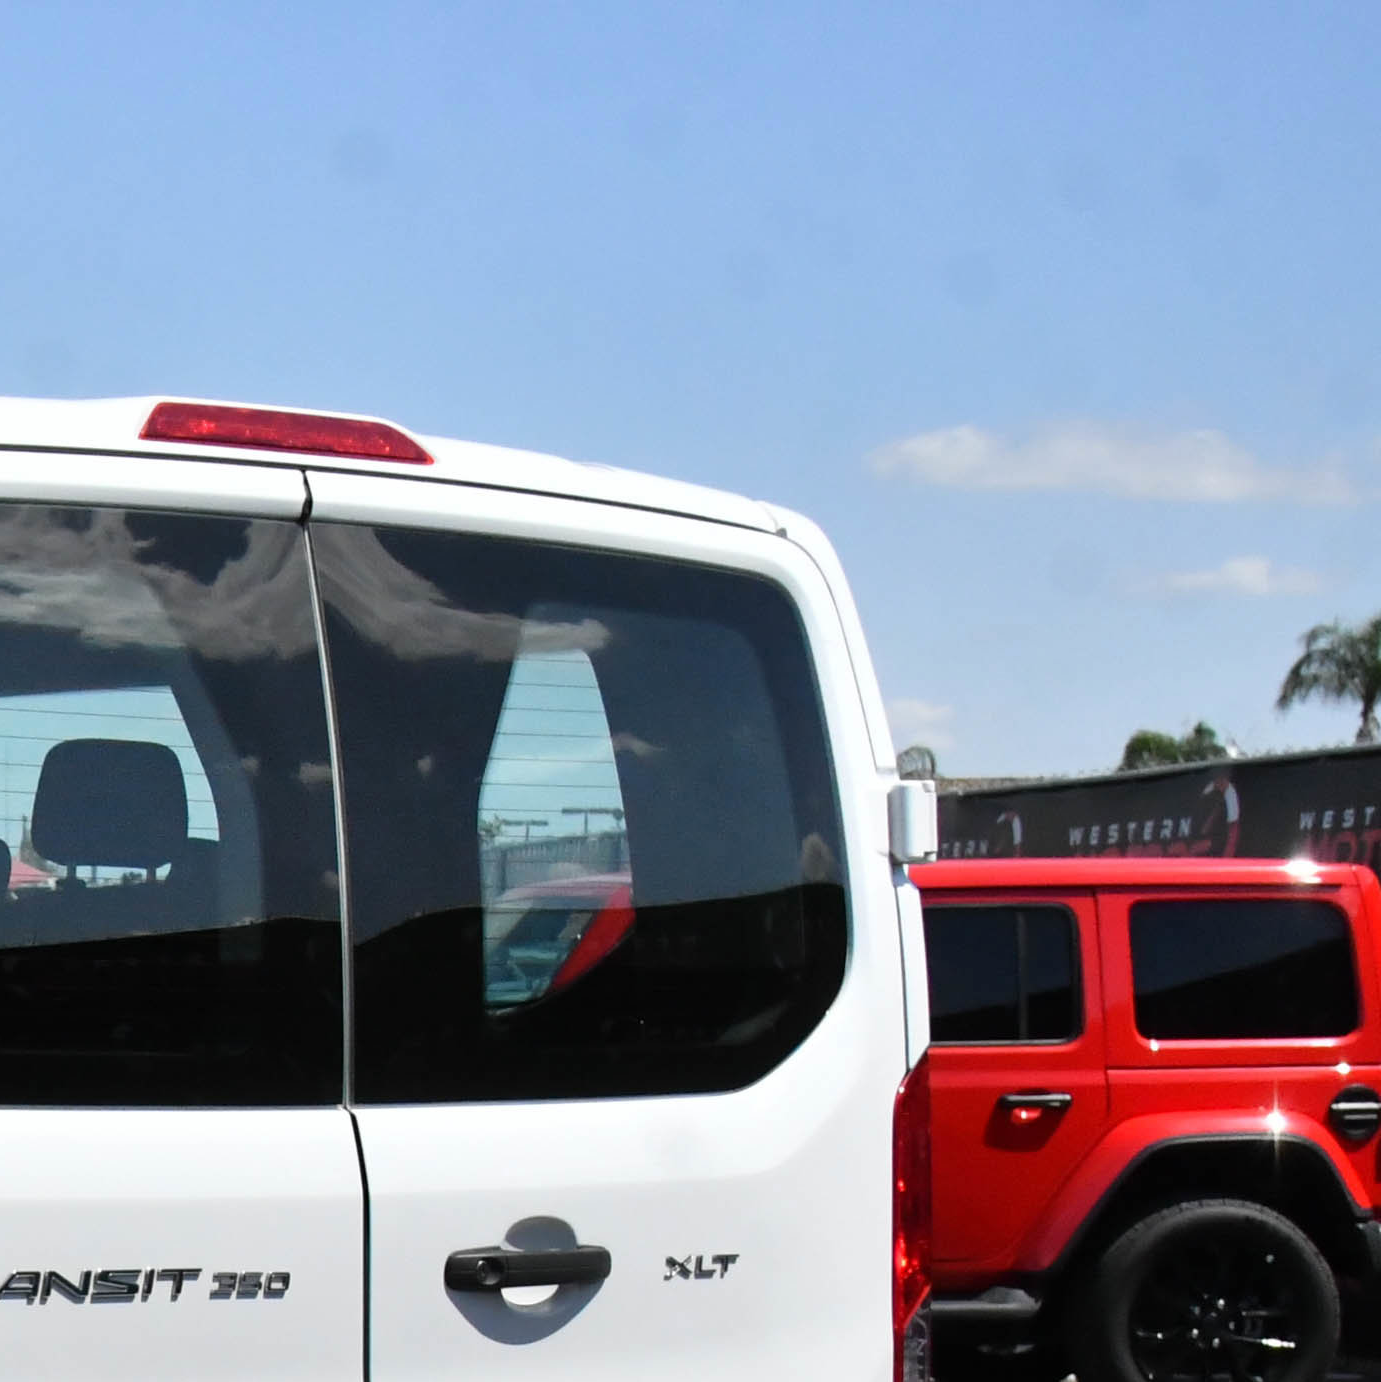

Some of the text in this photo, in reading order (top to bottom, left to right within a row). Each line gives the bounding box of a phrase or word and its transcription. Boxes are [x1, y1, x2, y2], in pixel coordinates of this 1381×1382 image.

[1068, 817, 1193, 847] WESTERN
[663, 1253, 740, 1281] XLT
[209, 1272, 290, 1300] 350
